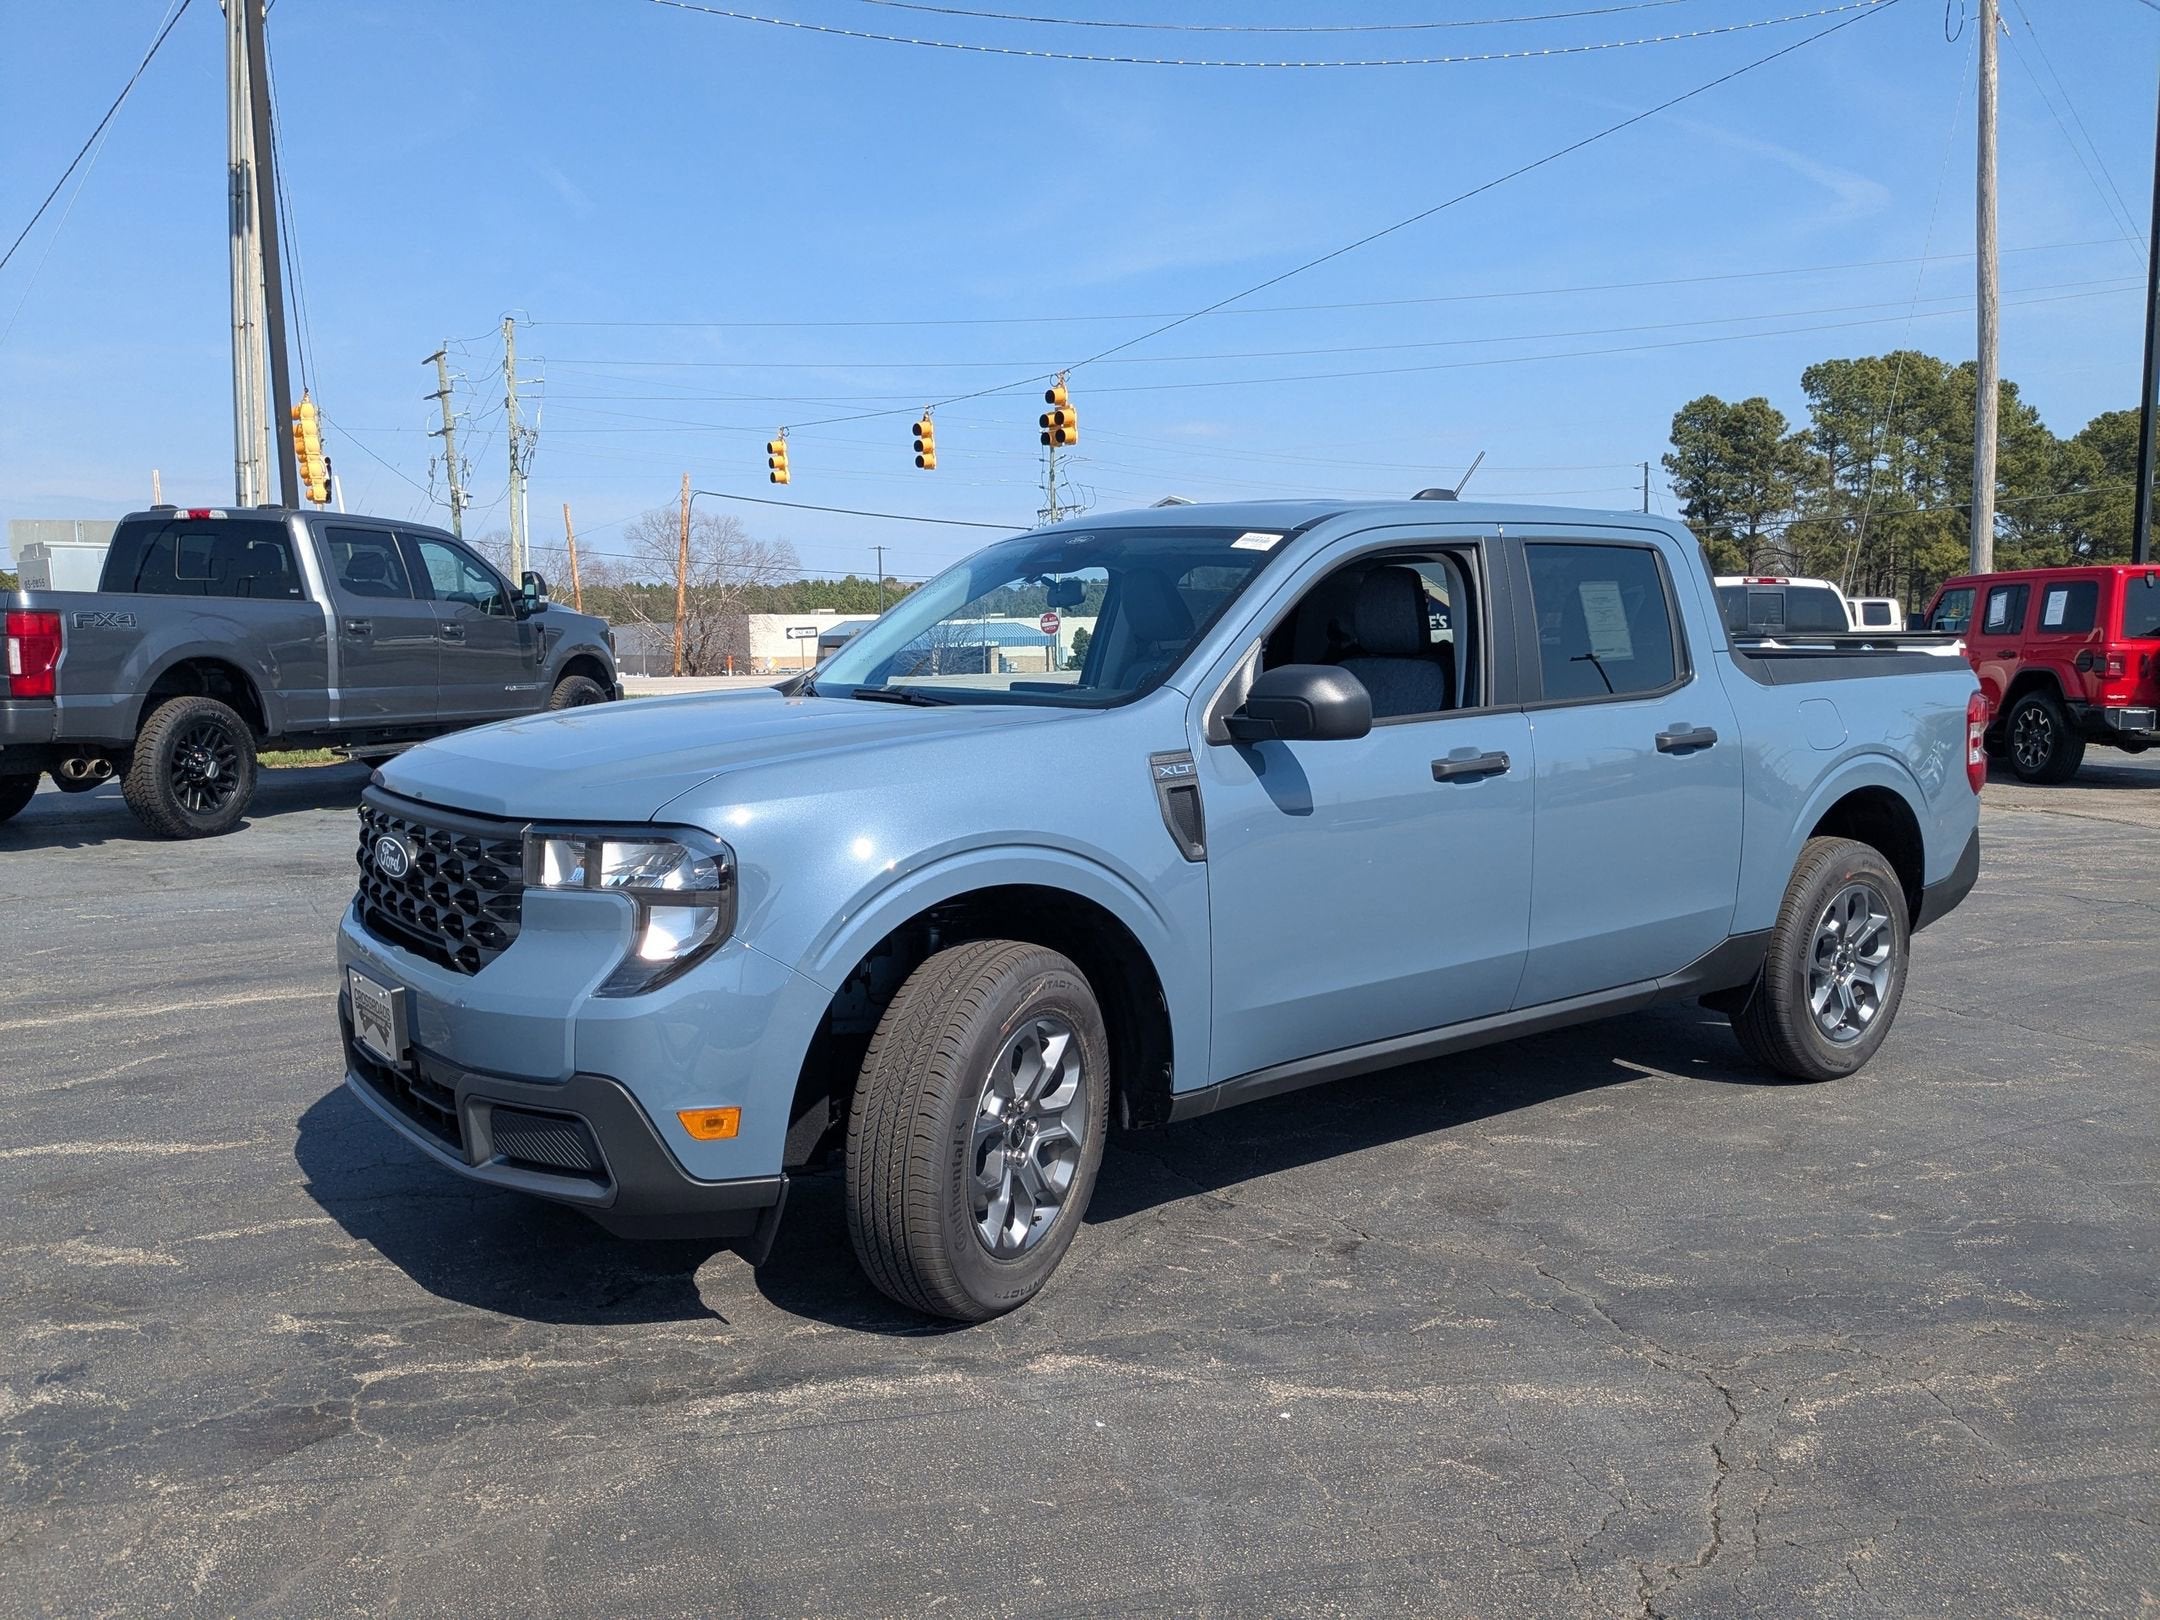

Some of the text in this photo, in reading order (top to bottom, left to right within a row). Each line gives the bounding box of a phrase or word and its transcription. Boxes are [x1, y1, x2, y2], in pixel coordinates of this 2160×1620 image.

[71, 611, 137, 630] FX4
[1160, 763, 1194, 777] XLT
[380, 840, 401, 873] Ford
[949, 1140, 967, 1253] Continental
